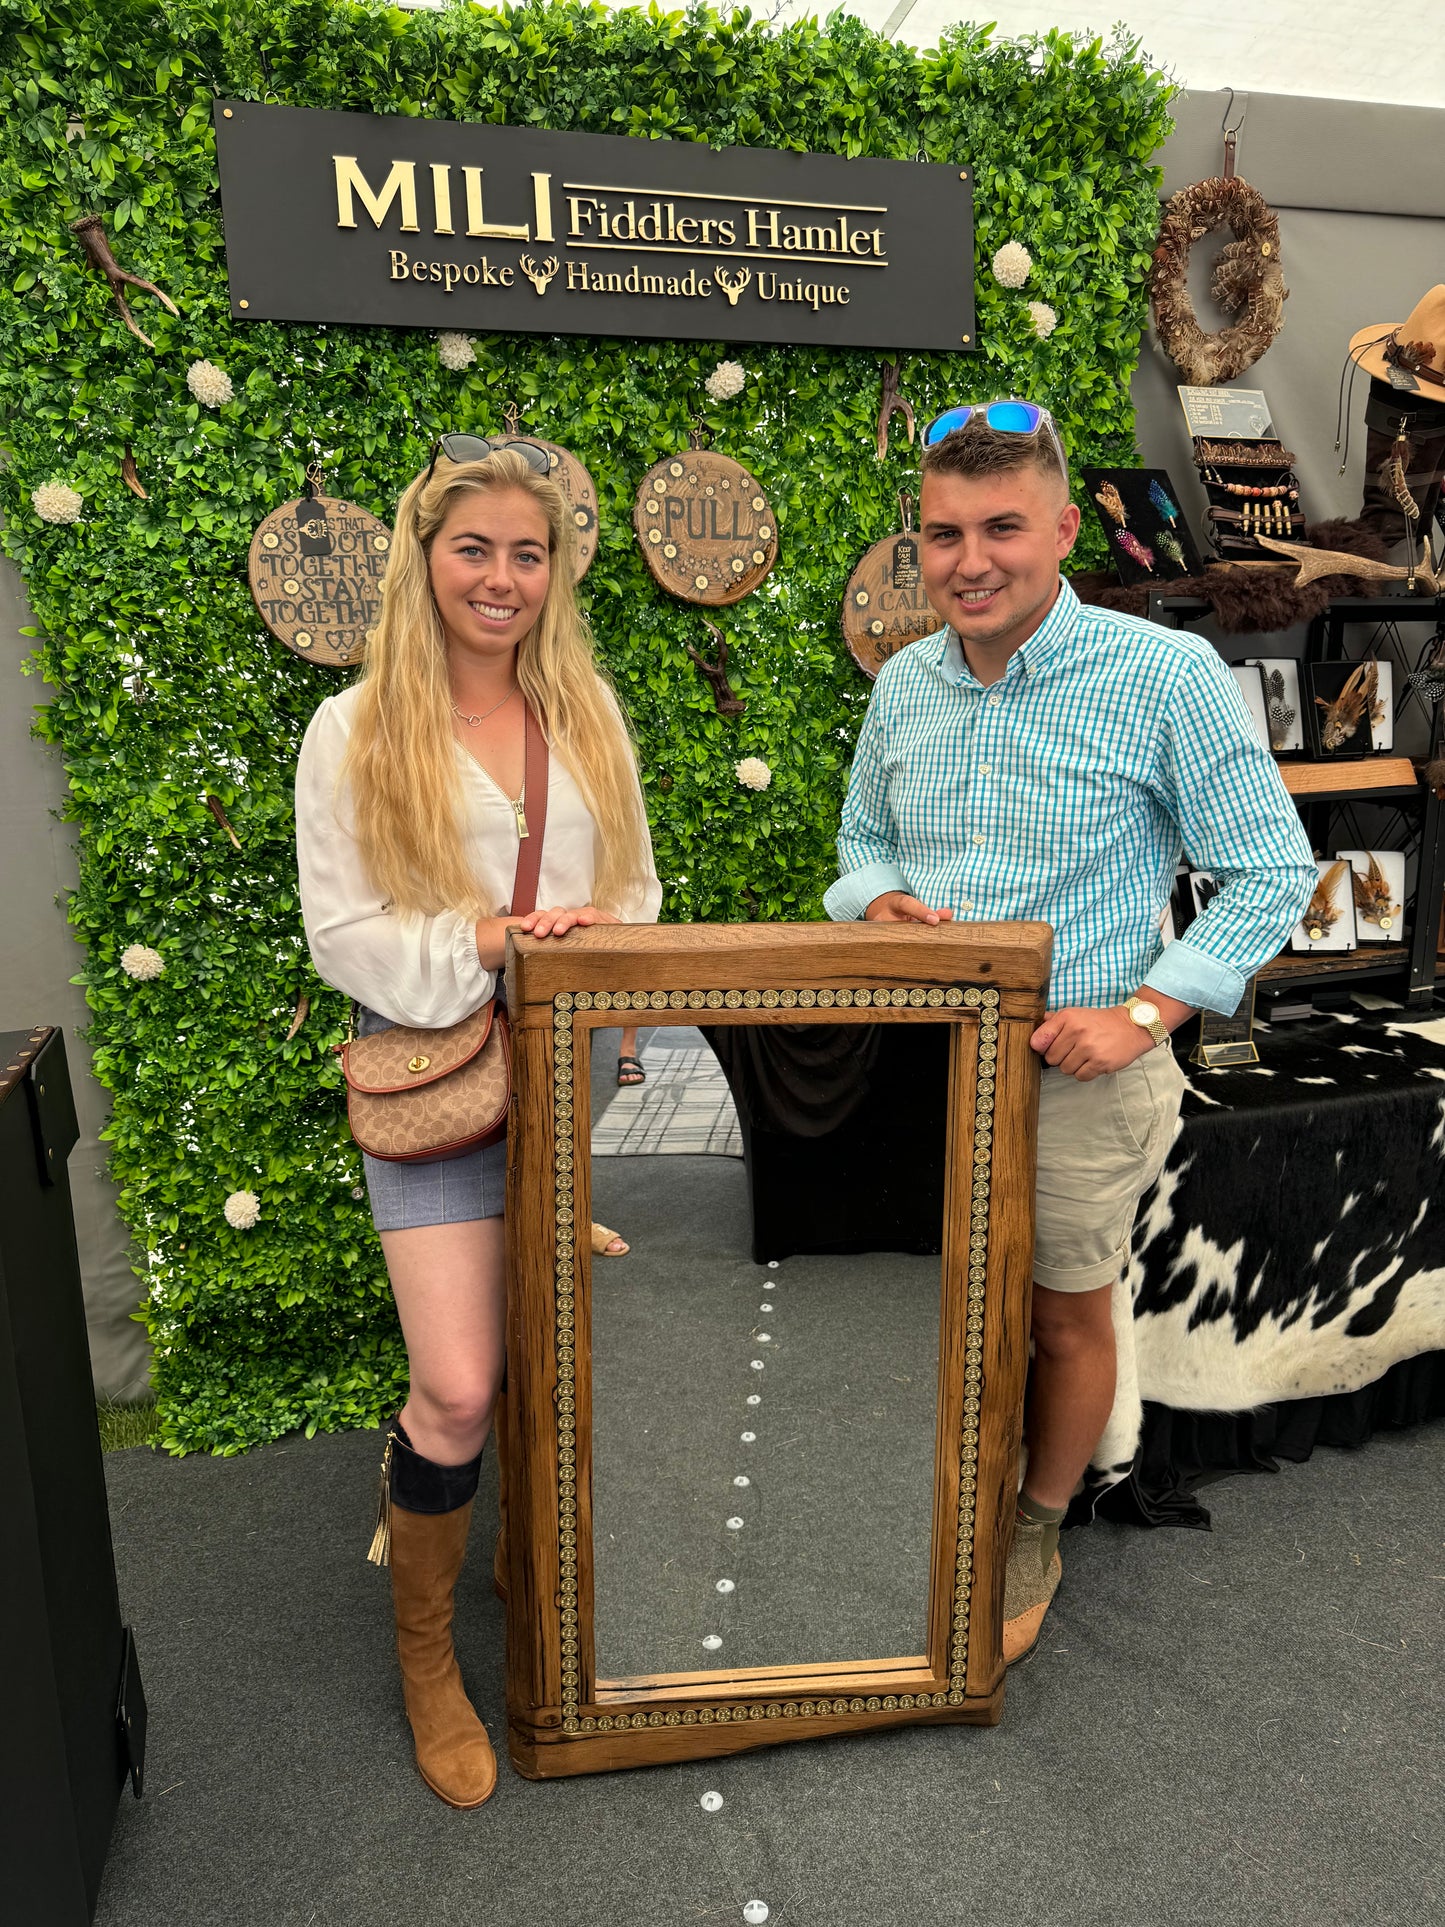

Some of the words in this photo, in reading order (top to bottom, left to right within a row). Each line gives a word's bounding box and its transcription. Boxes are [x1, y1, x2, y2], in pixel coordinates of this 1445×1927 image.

[332, 155, 555, 242] MILI
[566, 196, 737, 245] Fiddlers
[744, 208, 887, 257] Hamlet
[388, 250, 514, 292] Bespoke
[565, 261, 712, 298] Handmade
[756, 272, 850, 311] Unique
[336, 517, 366, 531] THAT
[664, 496, 753, 541] PULL
[282, 530, 375, 554] SOT
[259, 553, 391, 577] TOGETHE
[301, 577, 366, 601] STAY
[888, 614, 938, 638] AND
